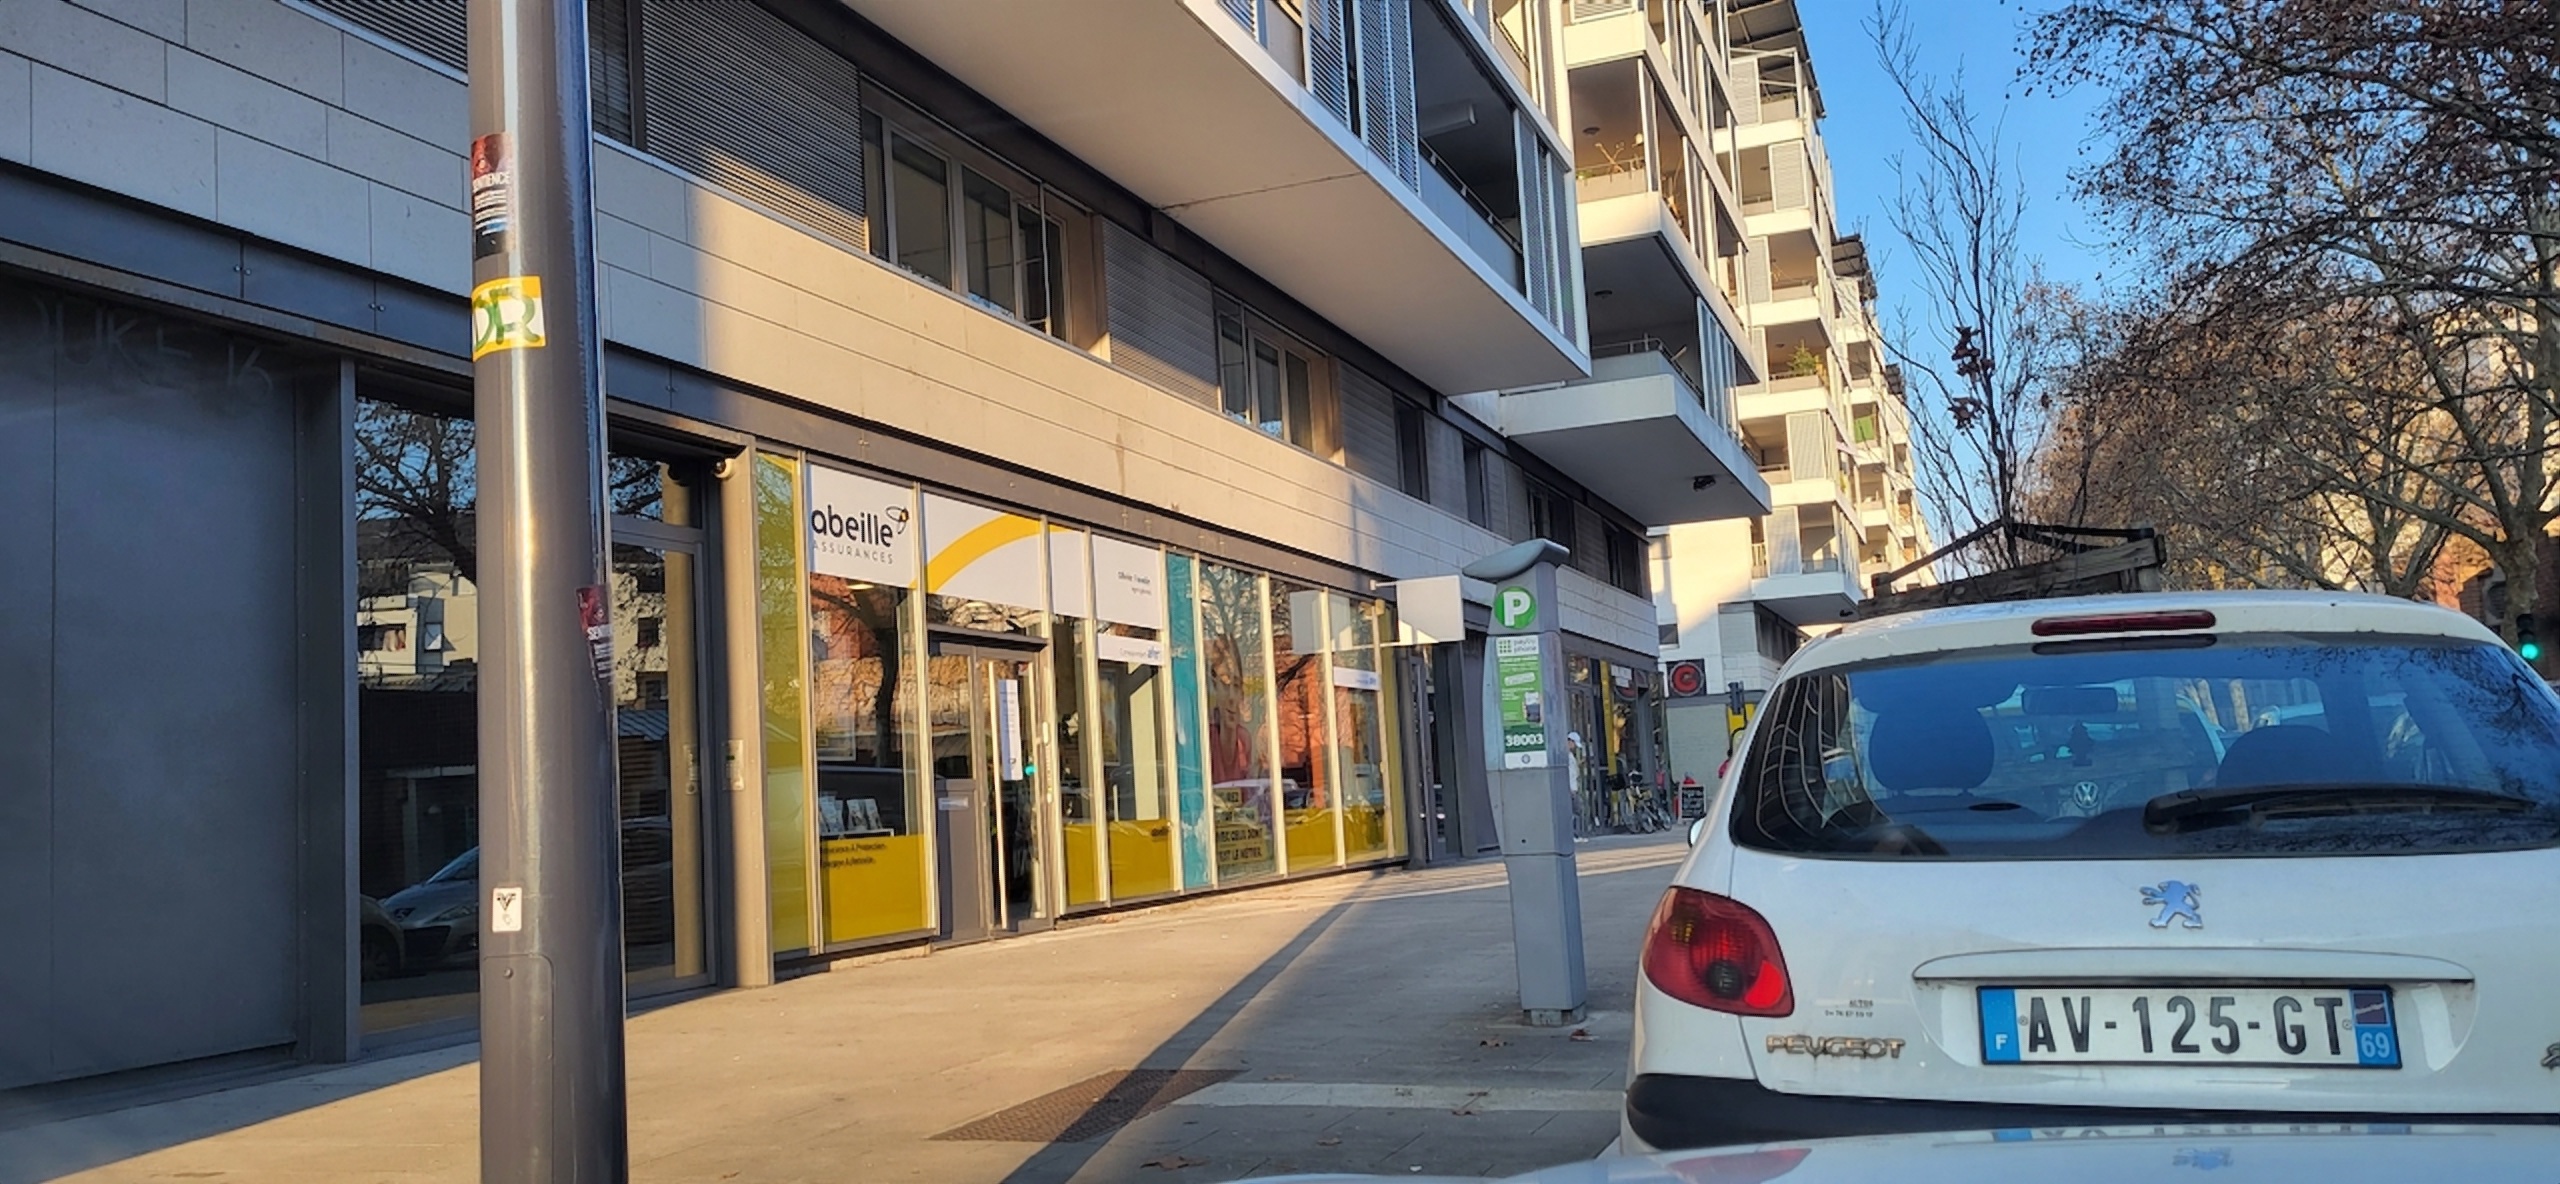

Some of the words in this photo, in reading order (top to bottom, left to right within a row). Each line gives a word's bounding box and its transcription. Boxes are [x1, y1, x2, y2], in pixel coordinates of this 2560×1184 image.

[811, 504, 893, 547] abeille
[813, 540, 893, 565] ASSURANCES
[1503, 591, 1531, 626] P
[1505, 733, 1544, 747] 38003
[2028, 995, 2343, 1056] AV-125-GT
[1766, 1034, 1906, 1060] PEUGEOT
[1996, 1034, 2008, 1050] F
[2361, 1032, 2390, 1059] 69
